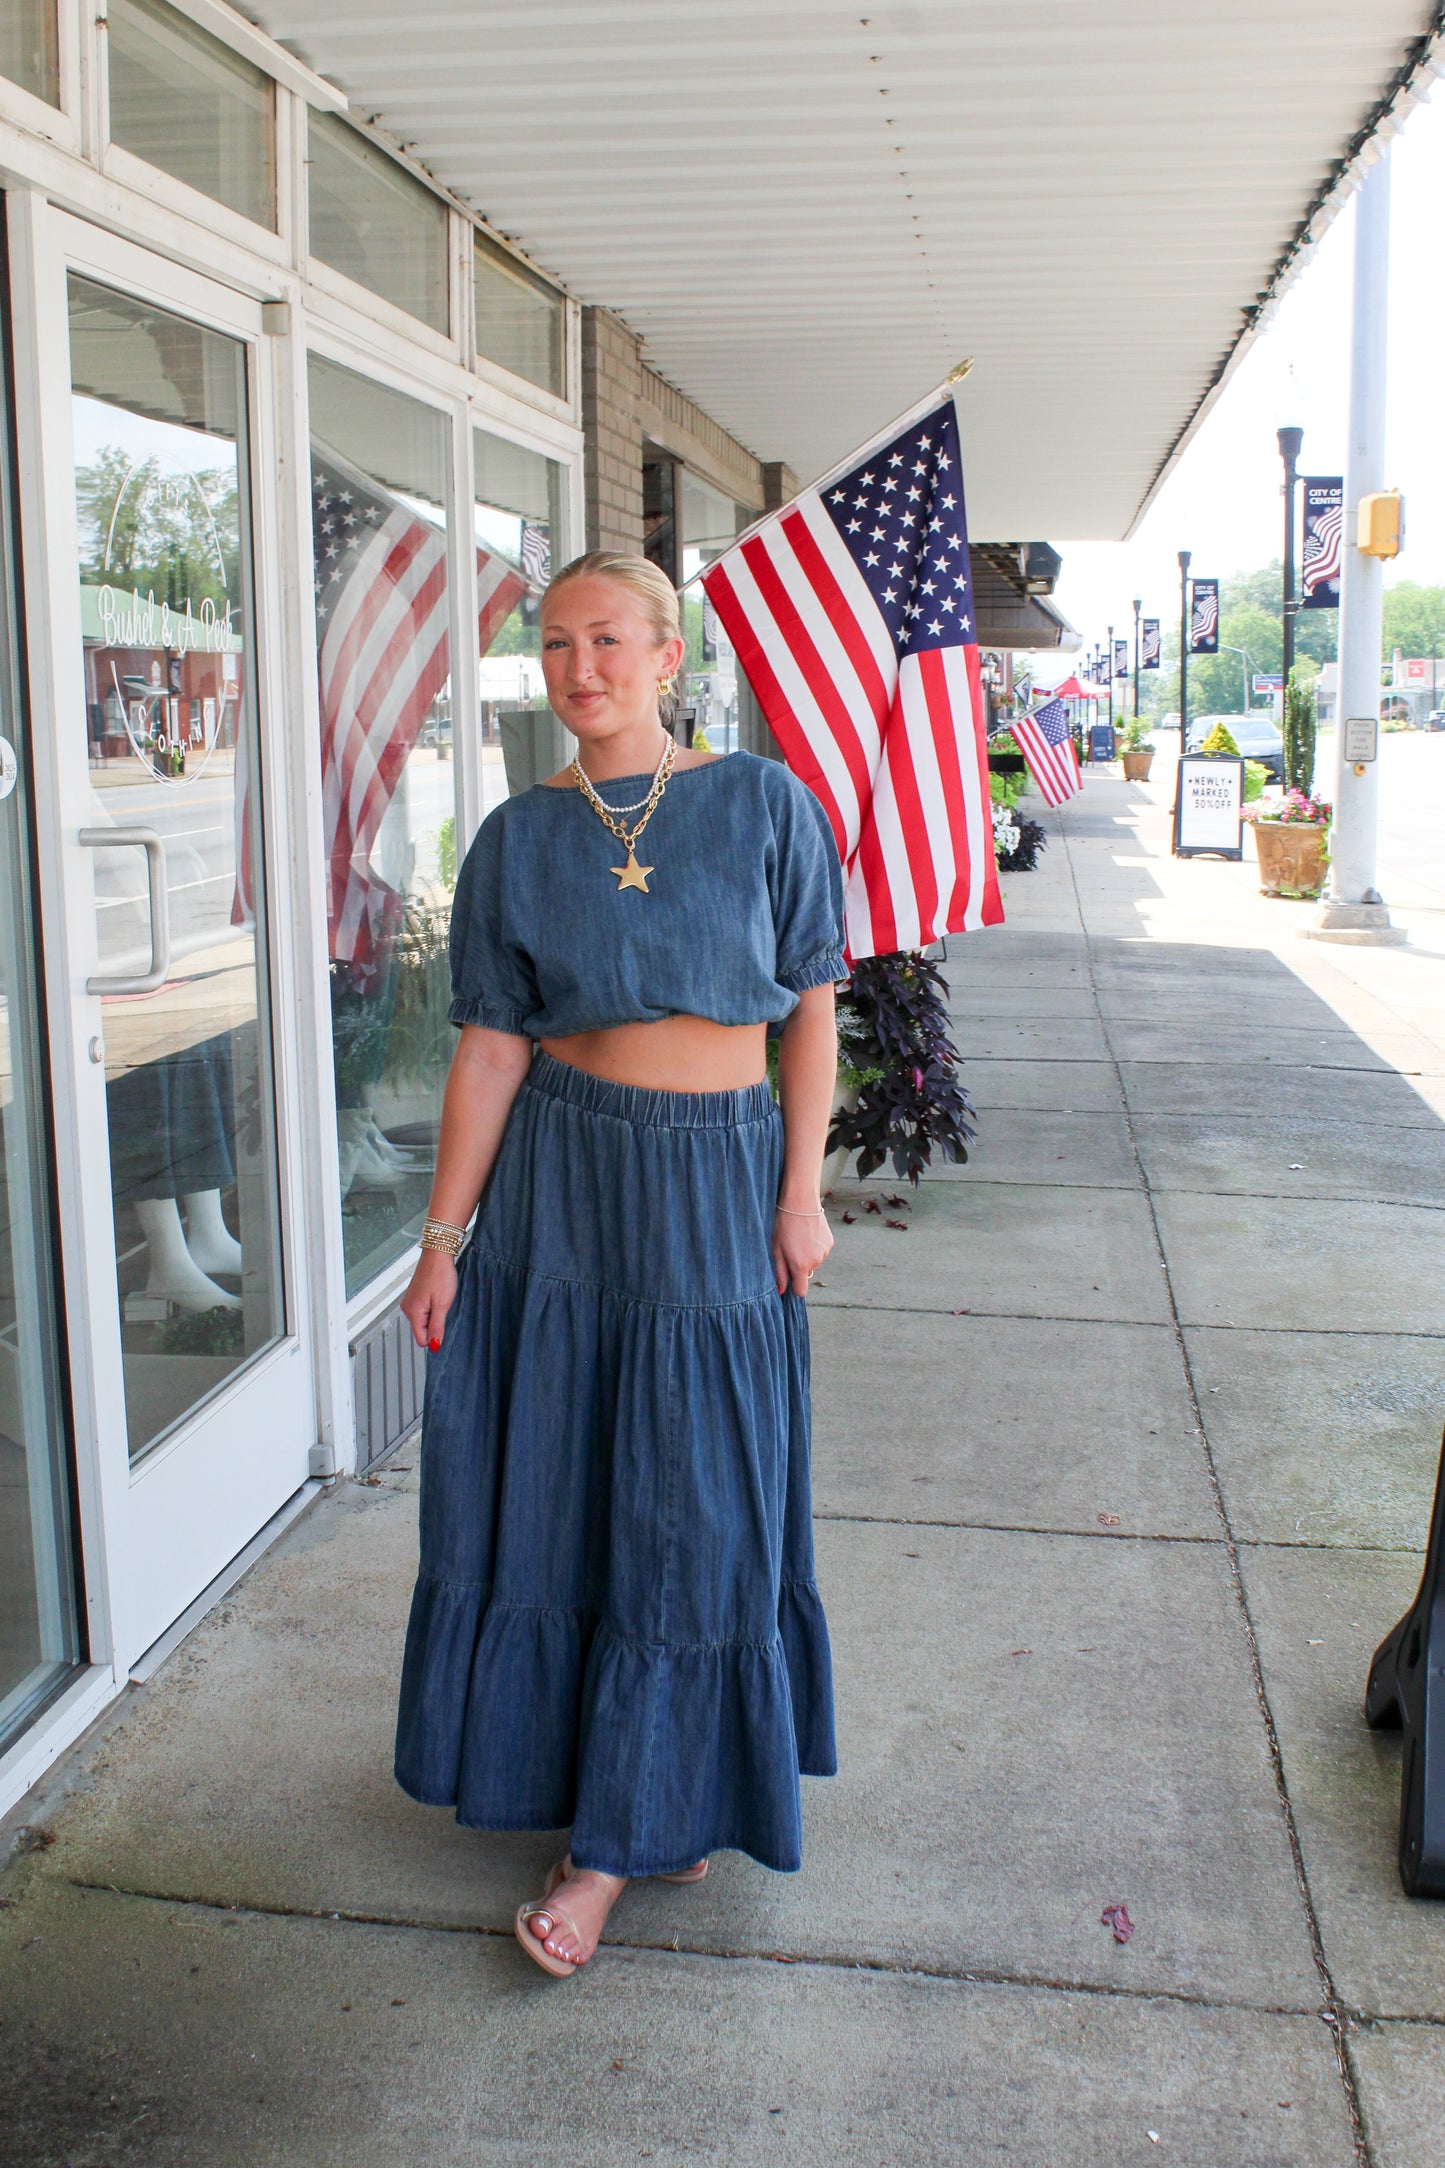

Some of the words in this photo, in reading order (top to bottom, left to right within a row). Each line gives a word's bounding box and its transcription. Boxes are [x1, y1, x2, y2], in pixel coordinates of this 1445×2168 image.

[1309, 488, 1329, 496] CITY
[1330, 488, 1343, 496] OF
[1309, 497, 1343, 505] CENTRE
[98, 584, 157, 647] Bushel
[161, 601, 176, 648] &
[1194, 776, 1225, 786] NEWLY
[1192, 788, 1229, 798] MARKED
